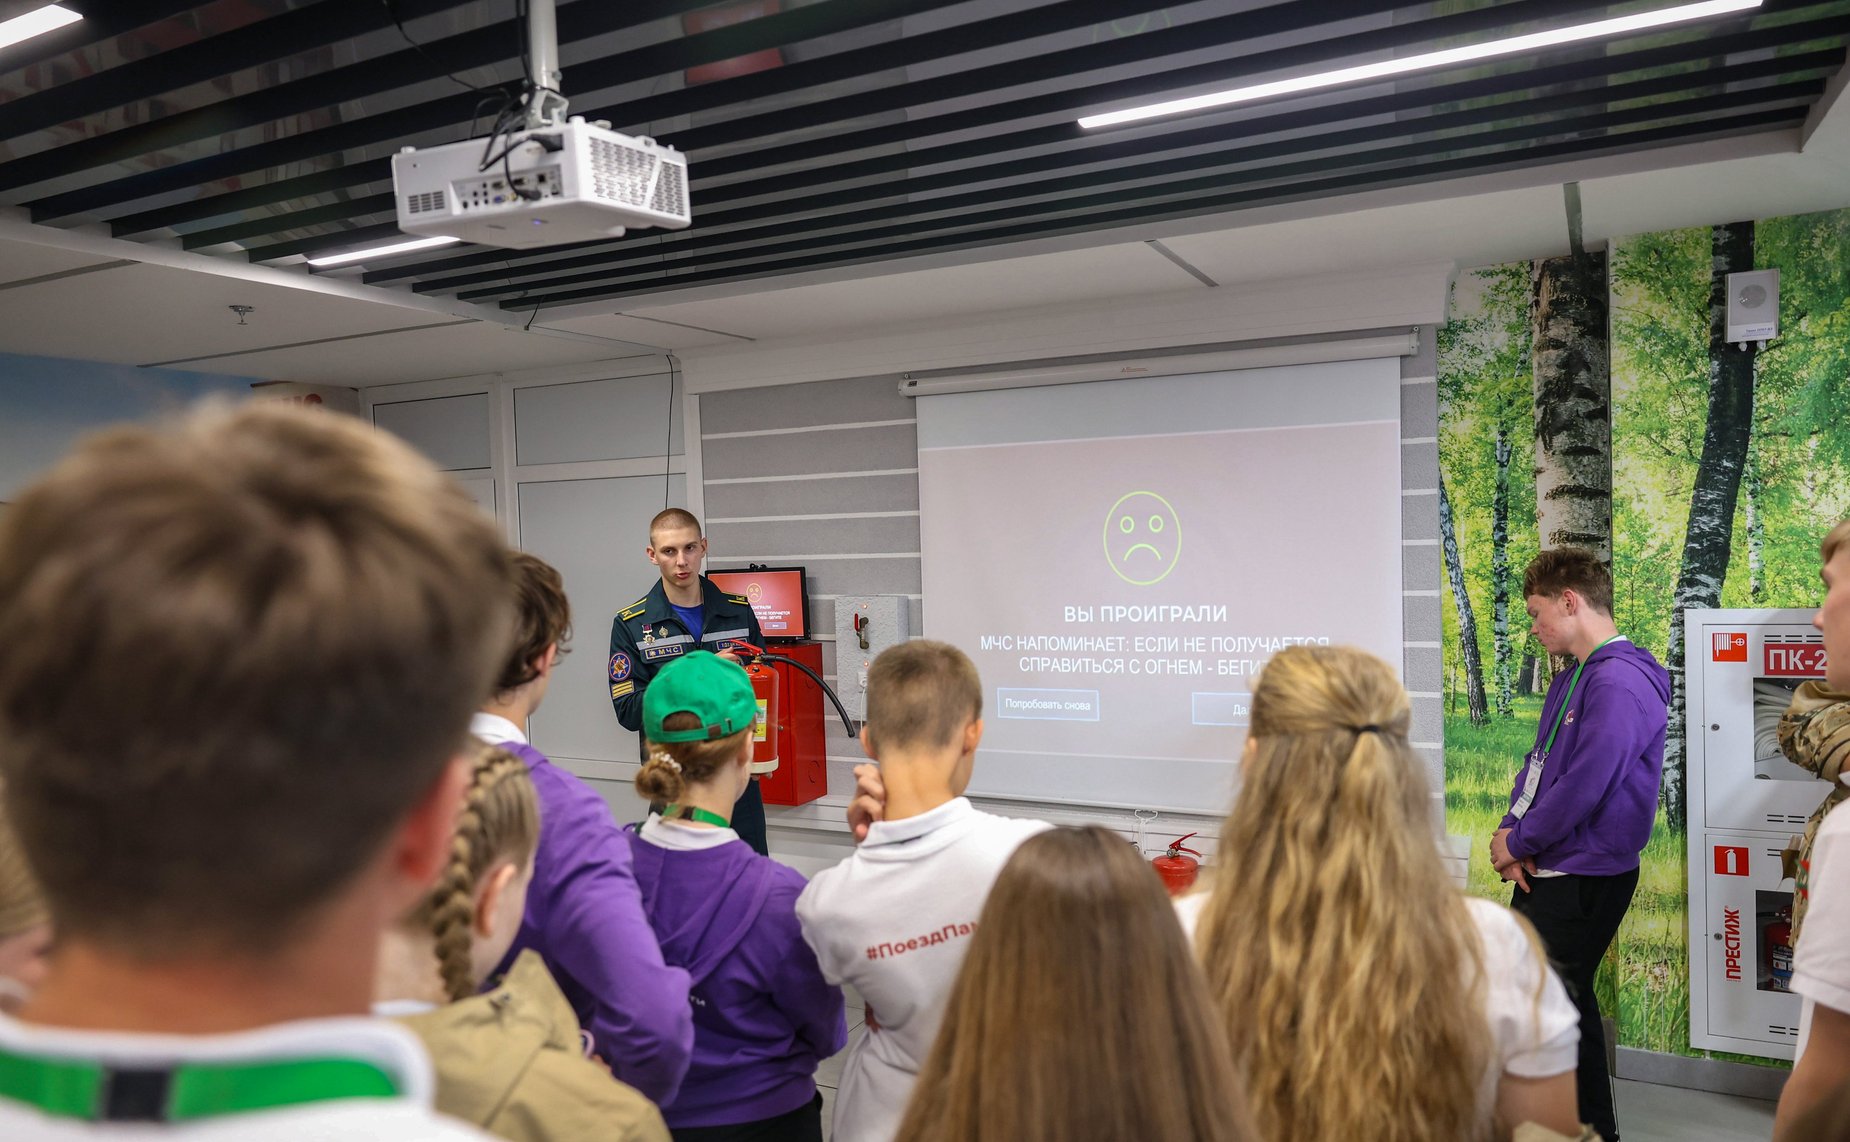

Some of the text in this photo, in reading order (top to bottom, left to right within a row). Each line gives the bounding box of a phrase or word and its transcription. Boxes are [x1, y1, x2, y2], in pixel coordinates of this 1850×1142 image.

[1064, 605, 1227, 623] ВЫ ПРОИГРАЛИ
[658, 647, 679, 656] МЧС
[980, 635, 1013, 651] МЧС
[1017, 636, 1130, 652] НАПОМИНАЕТ:
[1134, 637, 1179, 653] ЕСЛИ
[1184, 637, 1206, 653] НЕ
[1019, 656, 1124, 674] СПРАВИТЬСЯ
[1129, 658, 1141, 675] С
[1145, 659, 1203, 675] ОГНЕМ
[1769, 649, 1828, 671] ПК-2
[1005, 698, 1091, 711] Попробовать снова
[1233, 704, 1249, 717] Да
[1724, 909, 1742, 979] ПРЕСТИЖ
